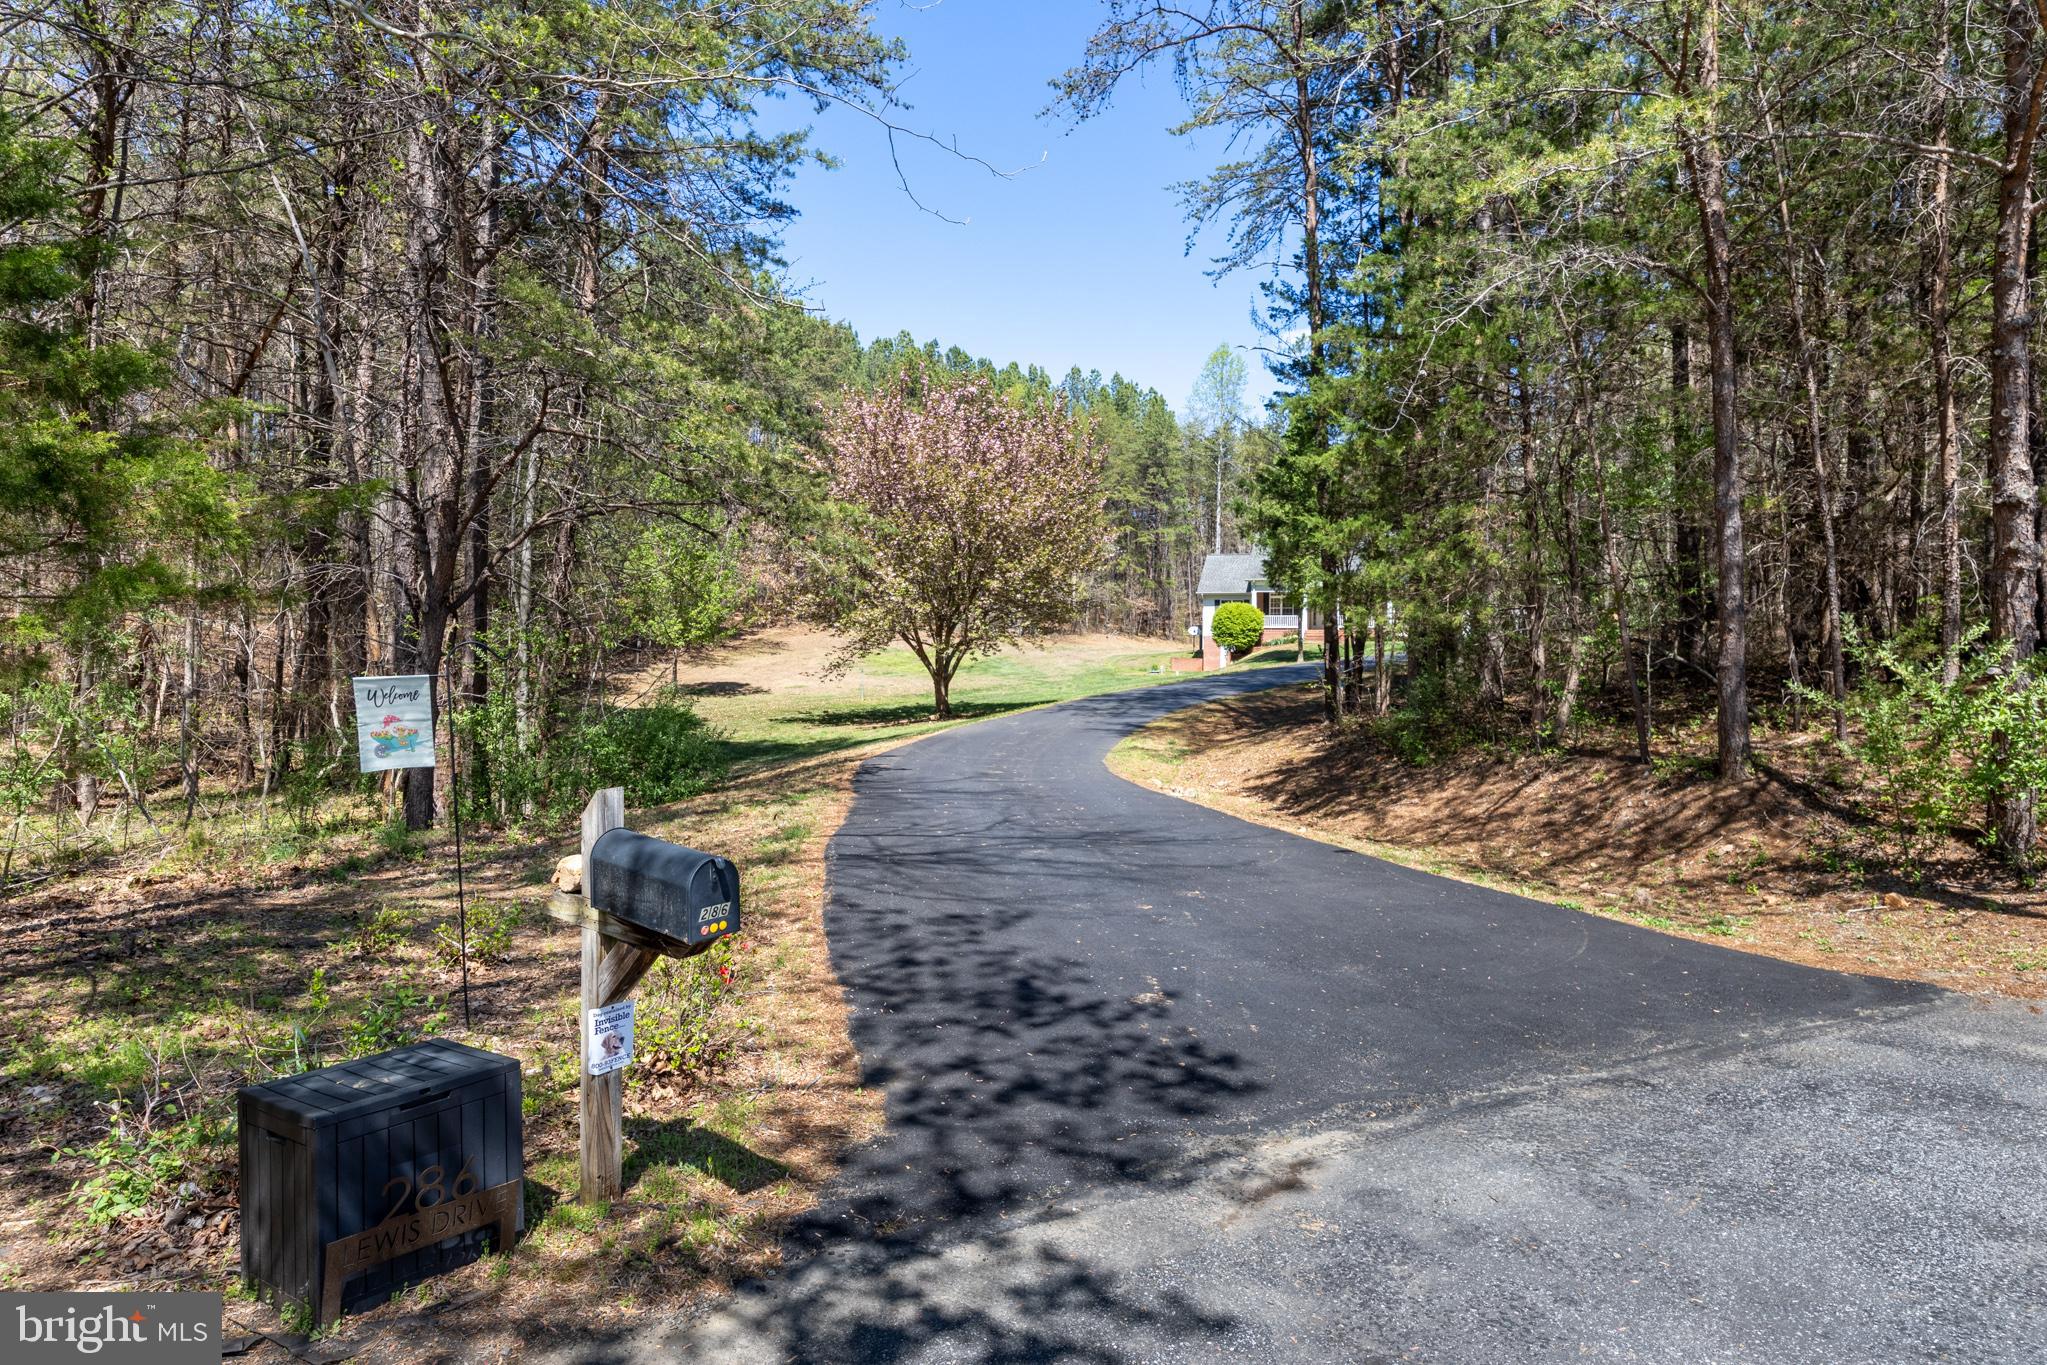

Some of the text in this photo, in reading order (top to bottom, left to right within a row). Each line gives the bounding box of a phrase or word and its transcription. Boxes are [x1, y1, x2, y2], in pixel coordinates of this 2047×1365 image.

[367, 685, 420, 708] Welcome
[700, 904, 729, 921] 286
[594, 1011, 630, 1028] Invisible
[594, 1023, 619, 1036] Fence
[380, 1154, 479, 1223] 286
[343, 1189, 508, 1268] LEWIS DRIVE
